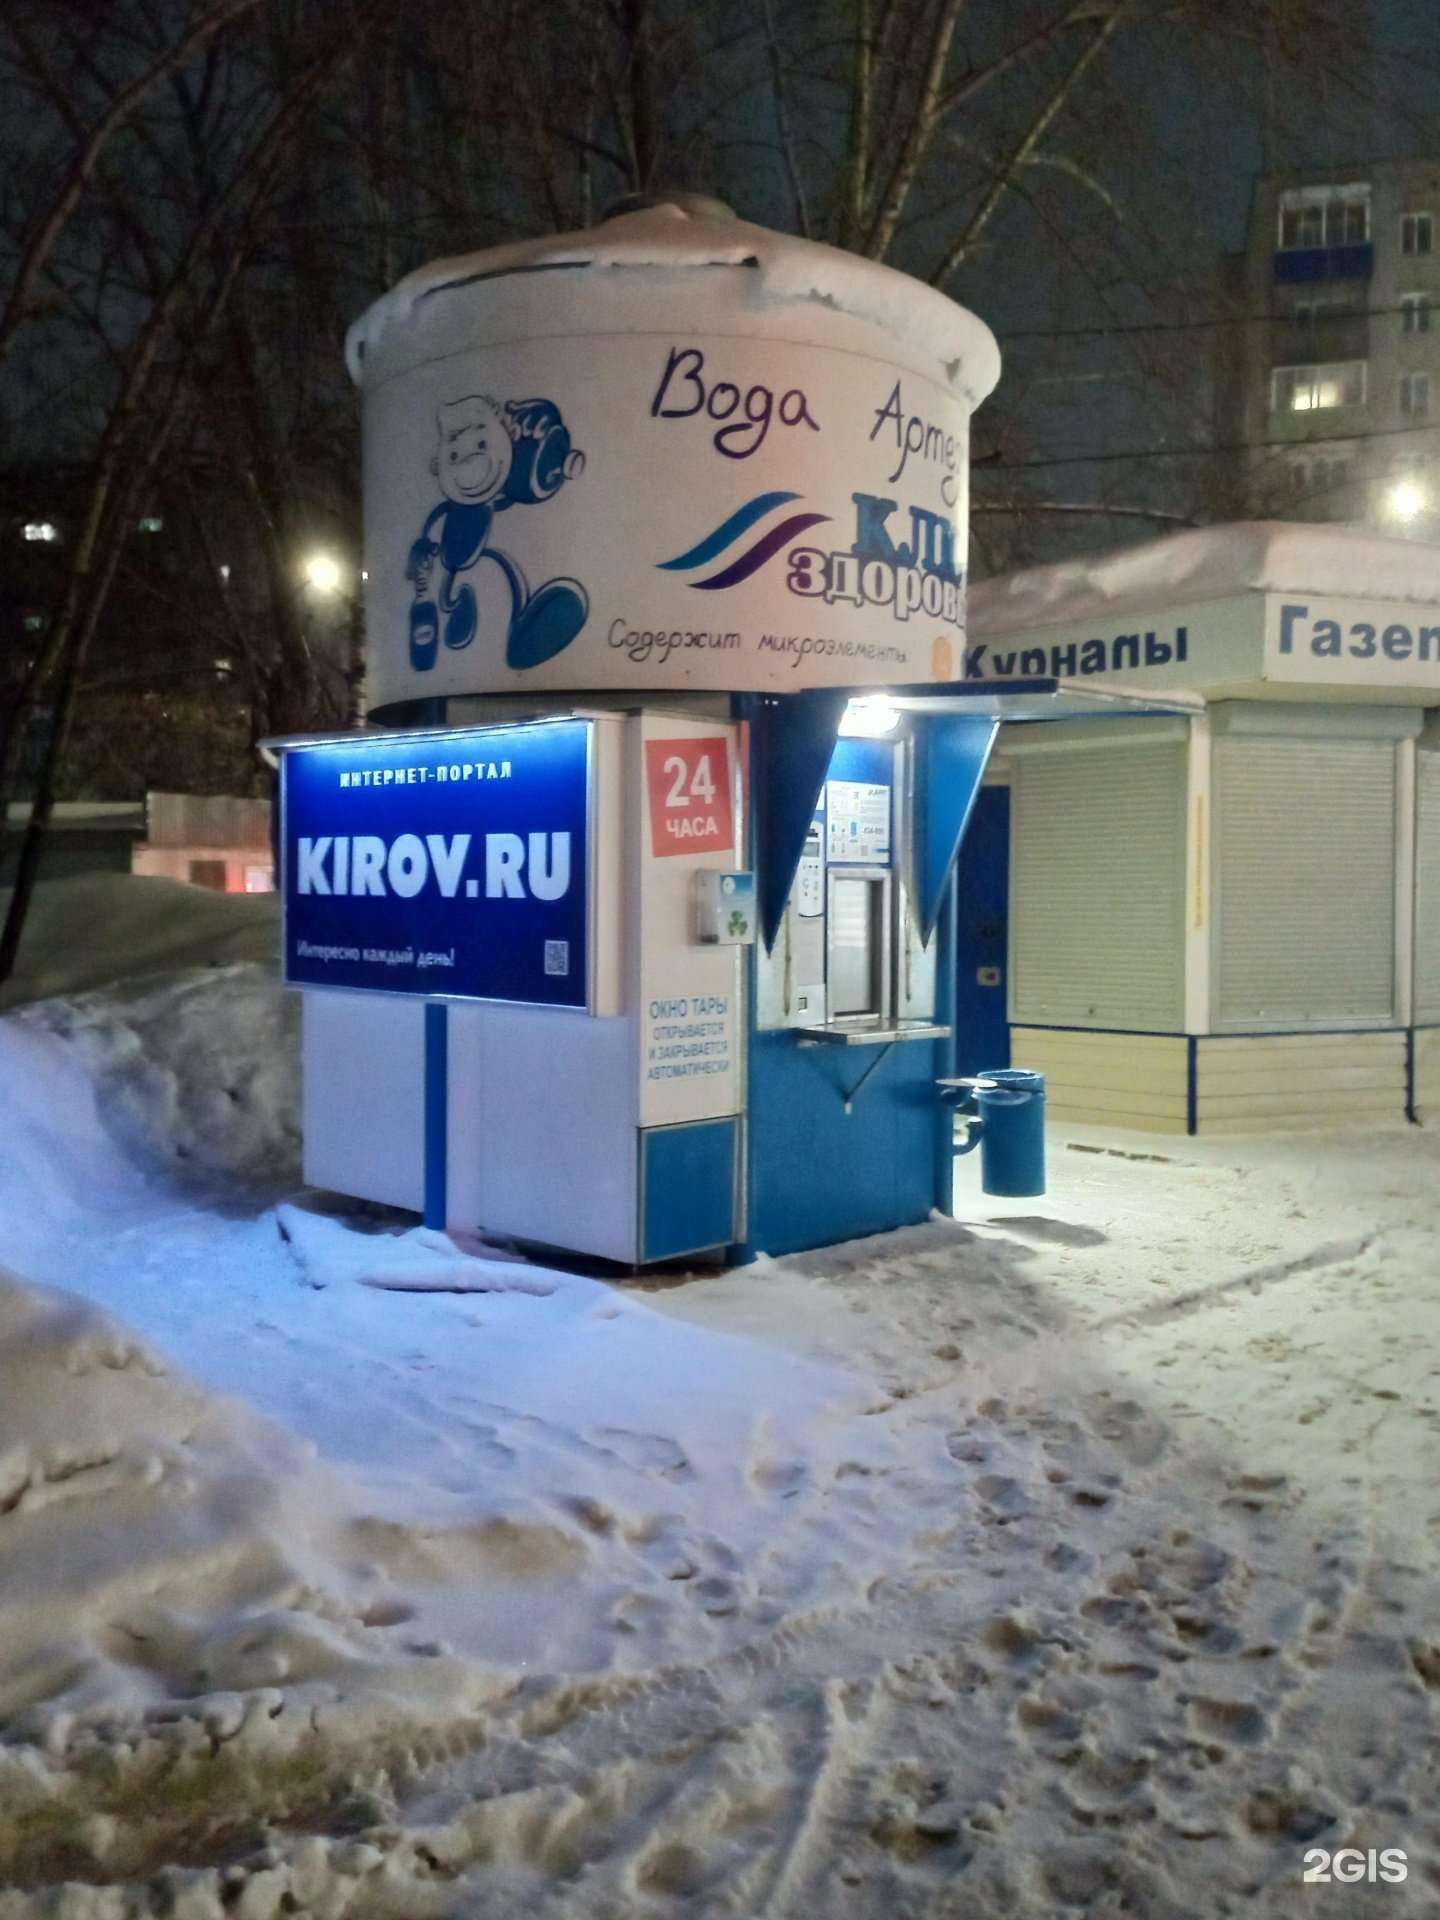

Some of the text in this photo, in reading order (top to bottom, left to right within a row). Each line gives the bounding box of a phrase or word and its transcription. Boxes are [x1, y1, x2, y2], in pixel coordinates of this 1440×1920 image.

[650, 346, 820, 459] Вода
[607, 618, 909, 668] Содержит микроэлементы
[339, 760, 513, 788] ИНТЕРНЕТ-ПОРТАЛ
[663, 755, 717, 808] 24
[665, 815, 719, 839] ЧАСА
[297, 831, 572, 901] KIROV.RU
[297, 939, 454, 968] Интересно каждый день!
[650, 997, 728, 1019] ОКНО ТАРЫ
[647, 1060, 729, 1080] АВТОМАТИЧЕСКИ
